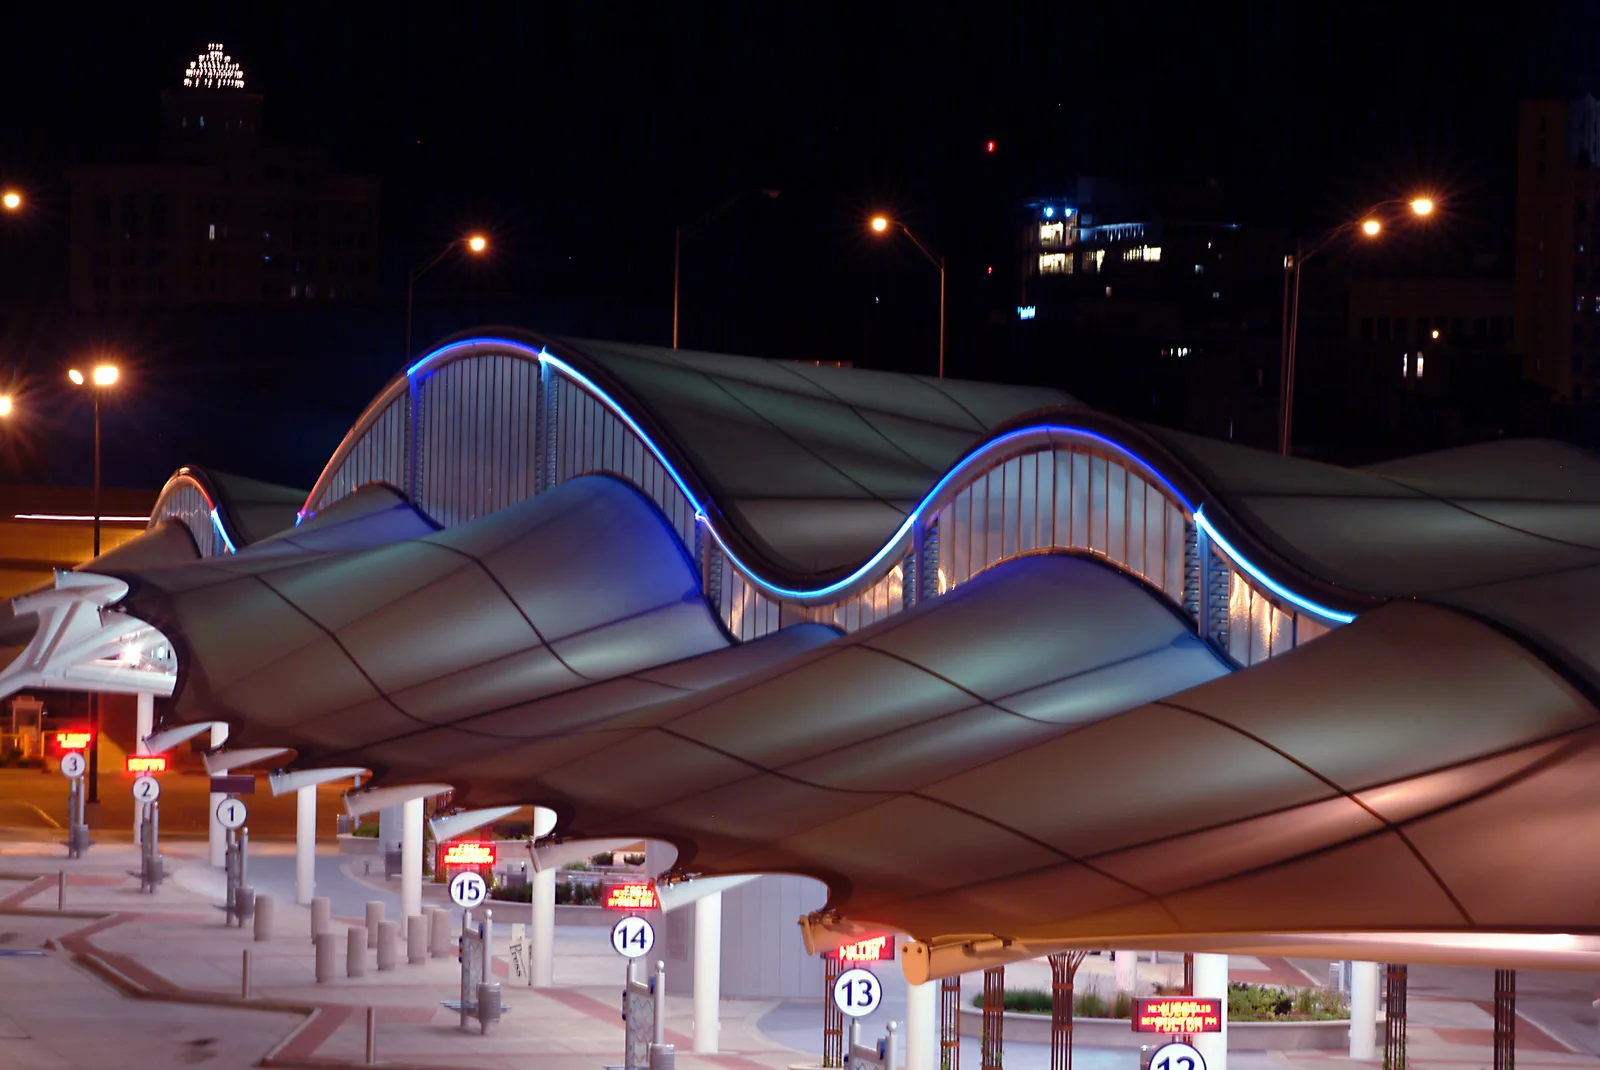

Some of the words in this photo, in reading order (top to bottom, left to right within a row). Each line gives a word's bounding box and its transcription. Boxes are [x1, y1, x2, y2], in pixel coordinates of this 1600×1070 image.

[69, 757, 78, 773] 3
[141, 782, 151, 798] 2
[227, 805, 235, 822] 1
[455, 879, 480, 901] 15
[618, 925, 646, 949] 14
[842, 979, 873, 1007] 13
